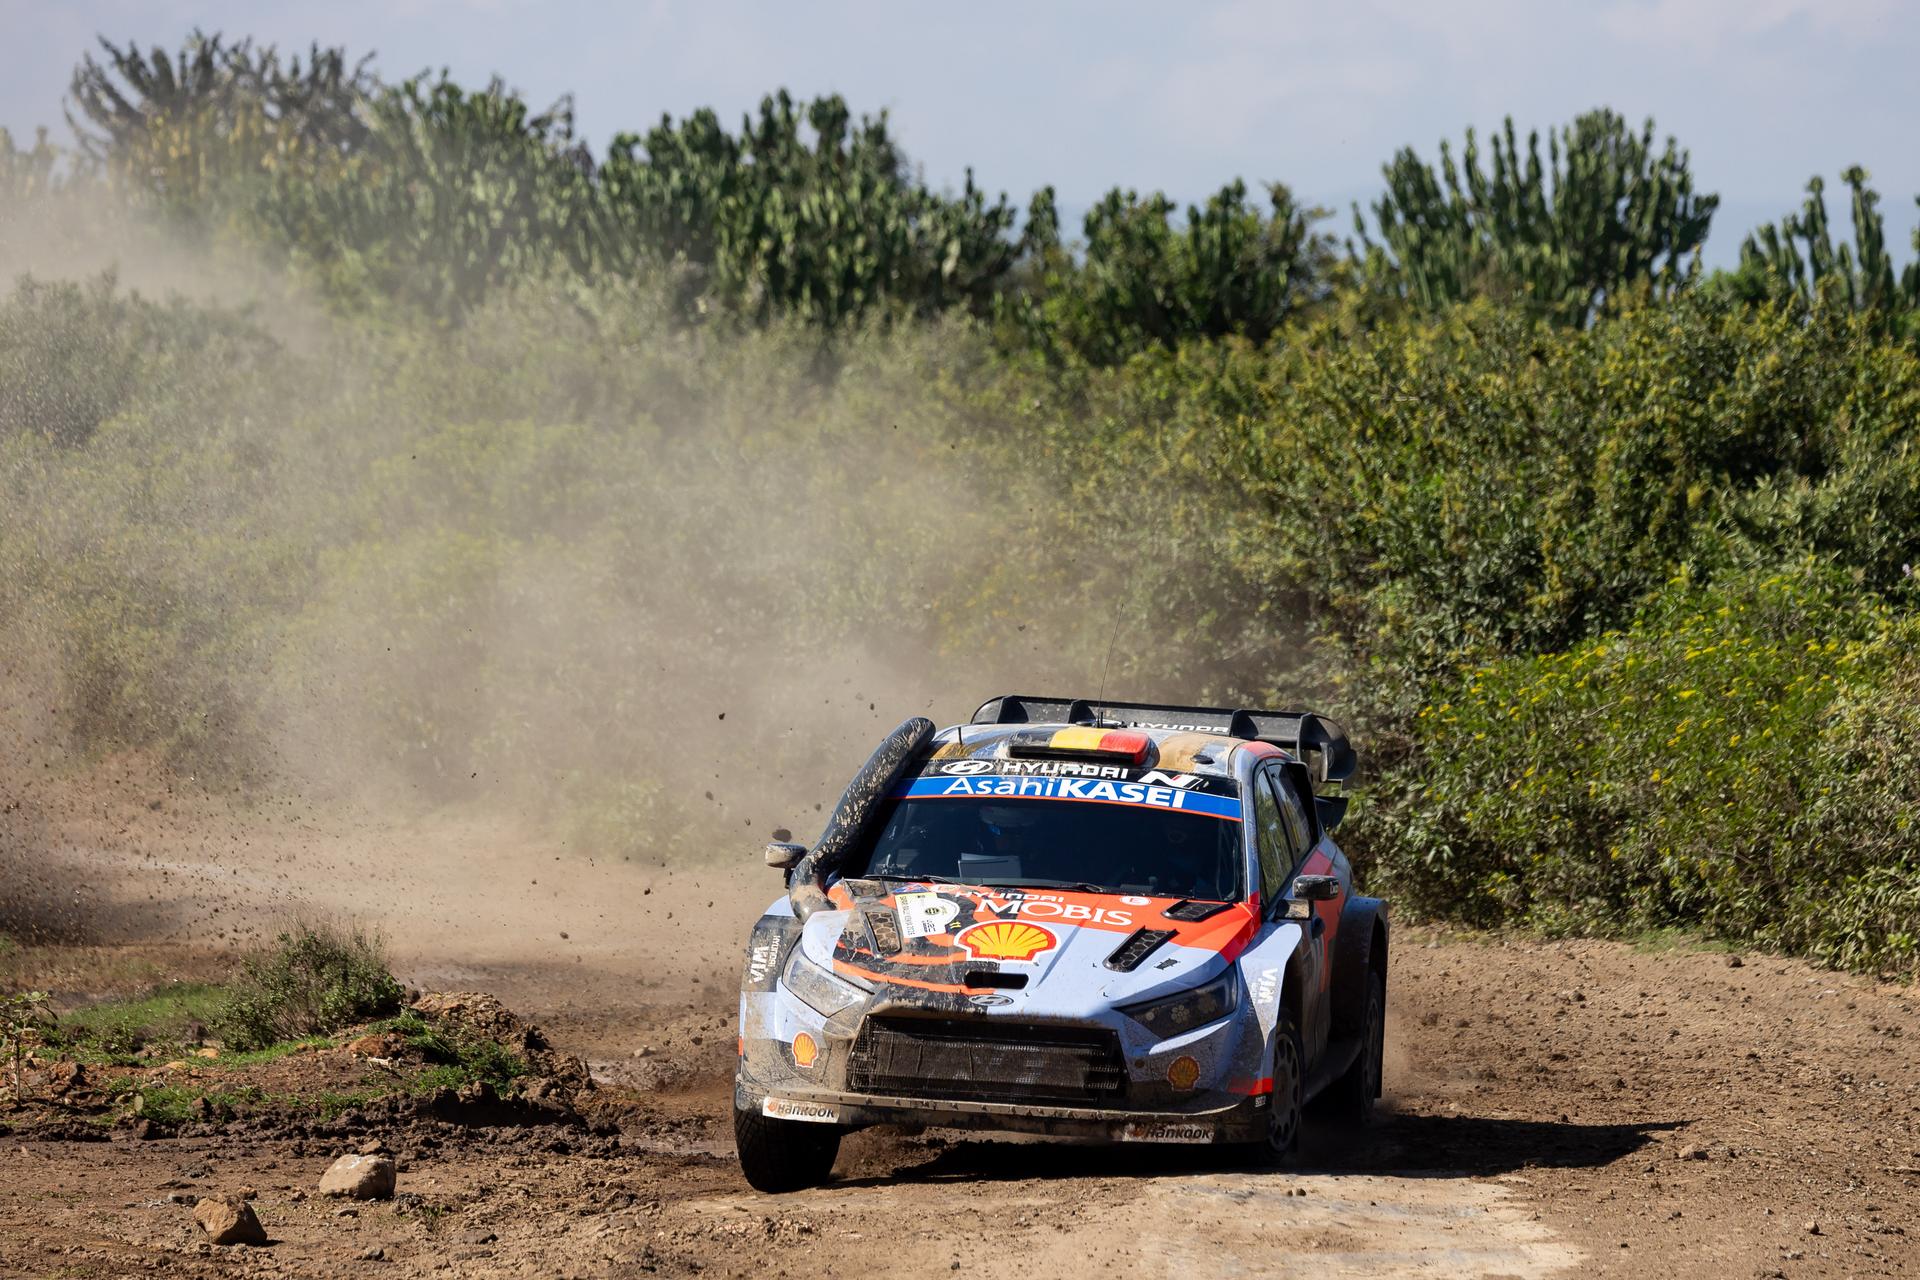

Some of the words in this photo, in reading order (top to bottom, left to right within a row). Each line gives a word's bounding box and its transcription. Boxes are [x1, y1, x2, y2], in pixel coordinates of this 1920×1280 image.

[1129, 721, 1229, 733] HYUNDA
[1002, 760, 1129, 780] HYUNDAI
[942, 776, 1187, 808] AsahiKASEI
[955, 889, 1065, 903] HYUNDAI
[976, 898, 1133, 927] MOBIS
